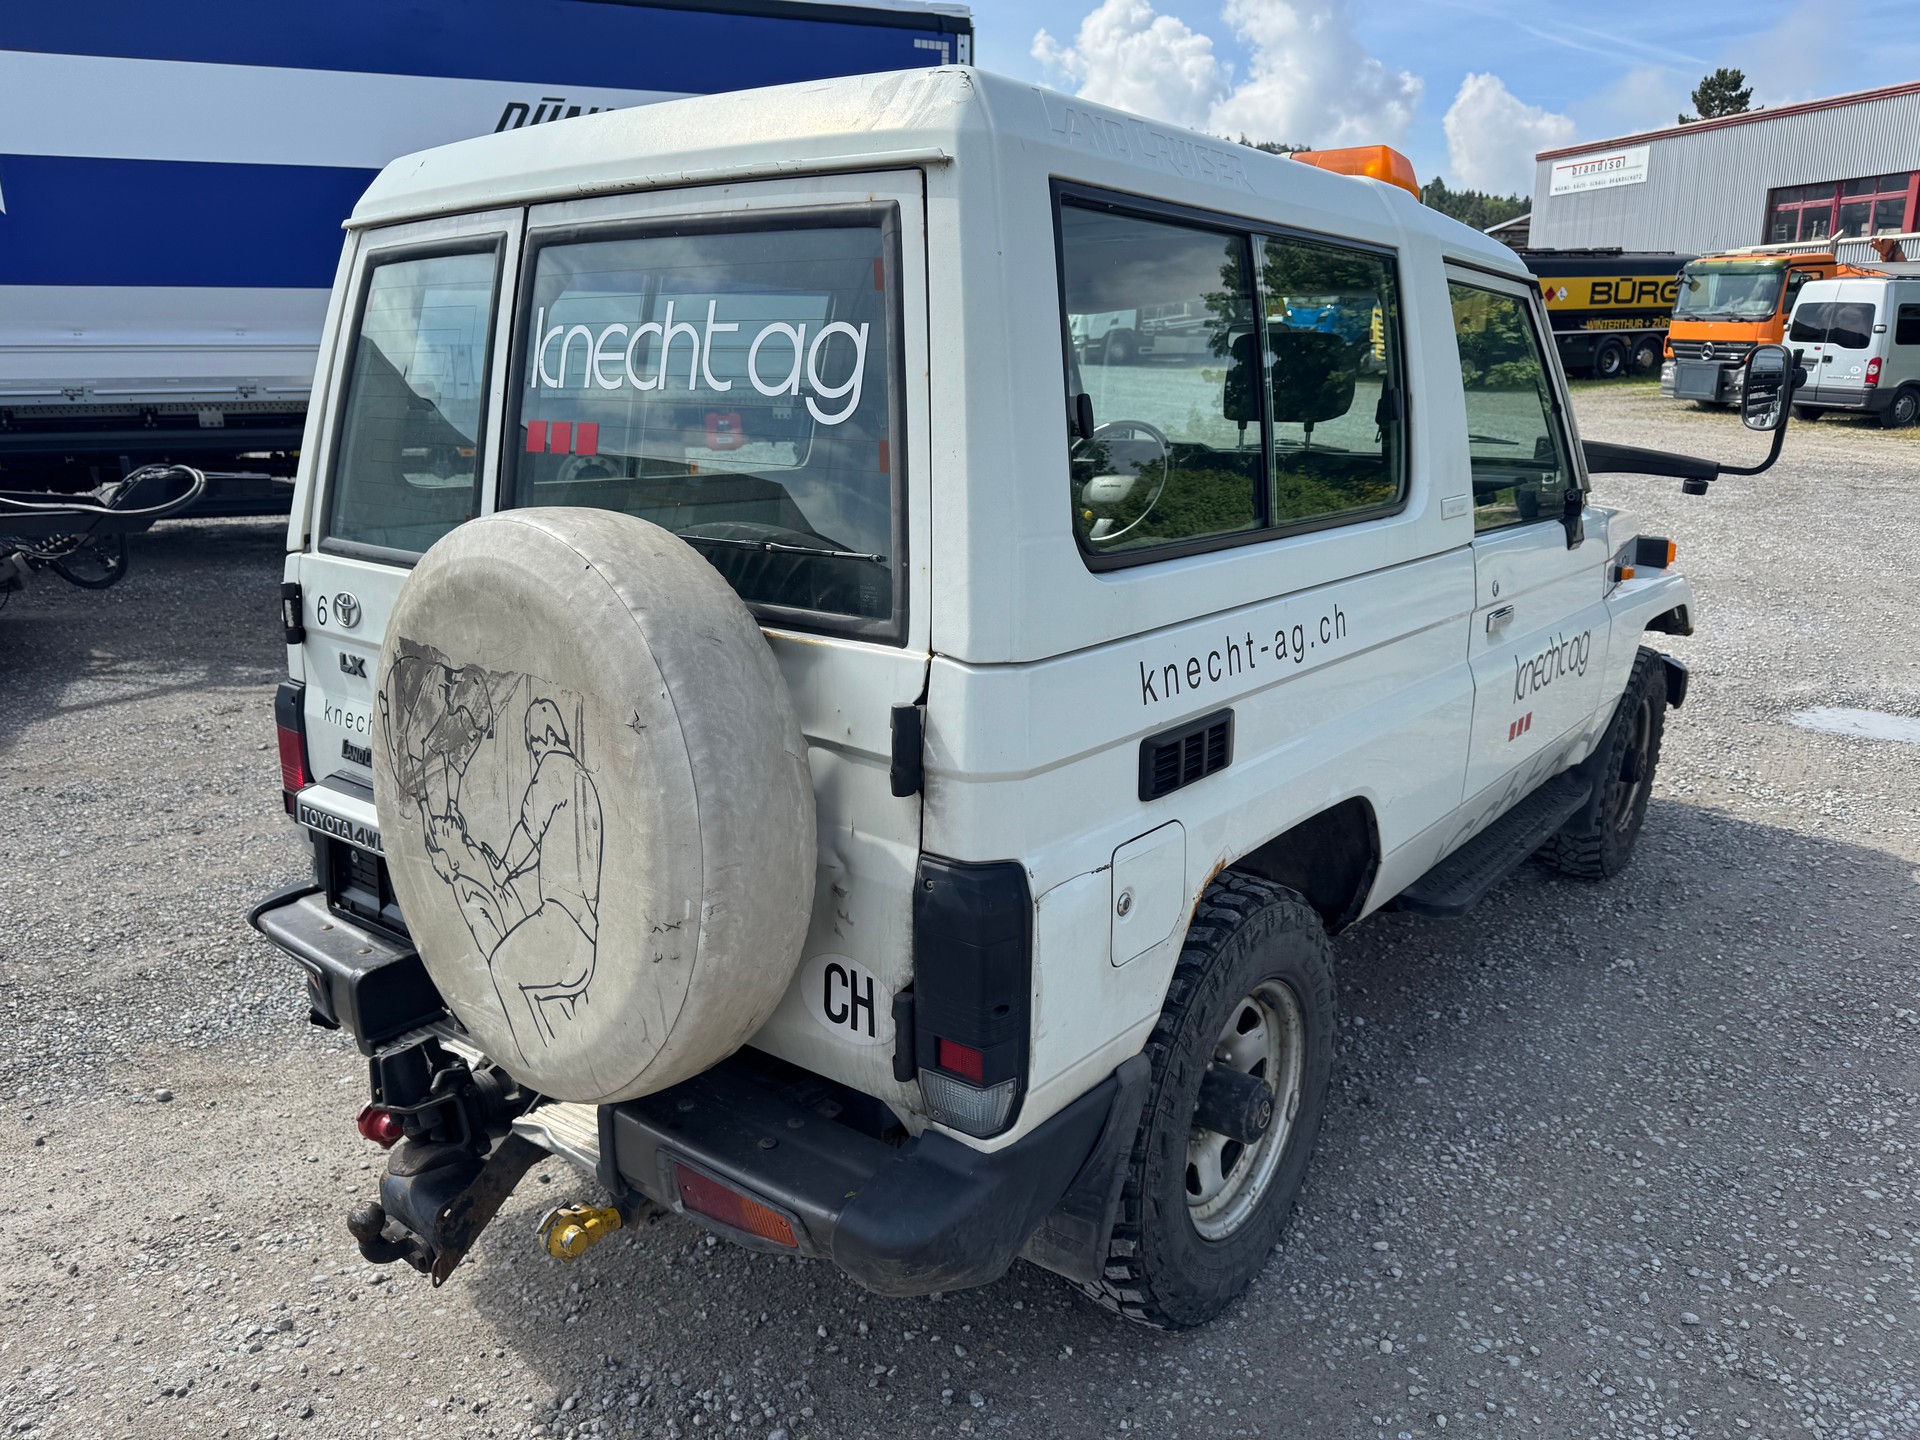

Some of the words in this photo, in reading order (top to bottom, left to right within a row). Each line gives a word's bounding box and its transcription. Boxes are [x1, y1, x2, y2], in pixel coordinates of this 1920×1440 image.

[1572, 156, 1626, 176] brandisol
[1586, 319, 1643, 330] WINTERTHUR
[531, 300, 739, 392] knecht
[748, 321, 870, 426] ag
[317, 595, 328, 626] 6
[339, 652, 367, 679] LX
[1139, 603, 1347, 706] knecht-ag.ch
[1513, 632, 1569, 704] knecht
[1568, 629, 1591, 677] ag
[302, 806, 352, 839] TOYOTA
[823, 962, 876, 1038] CH
